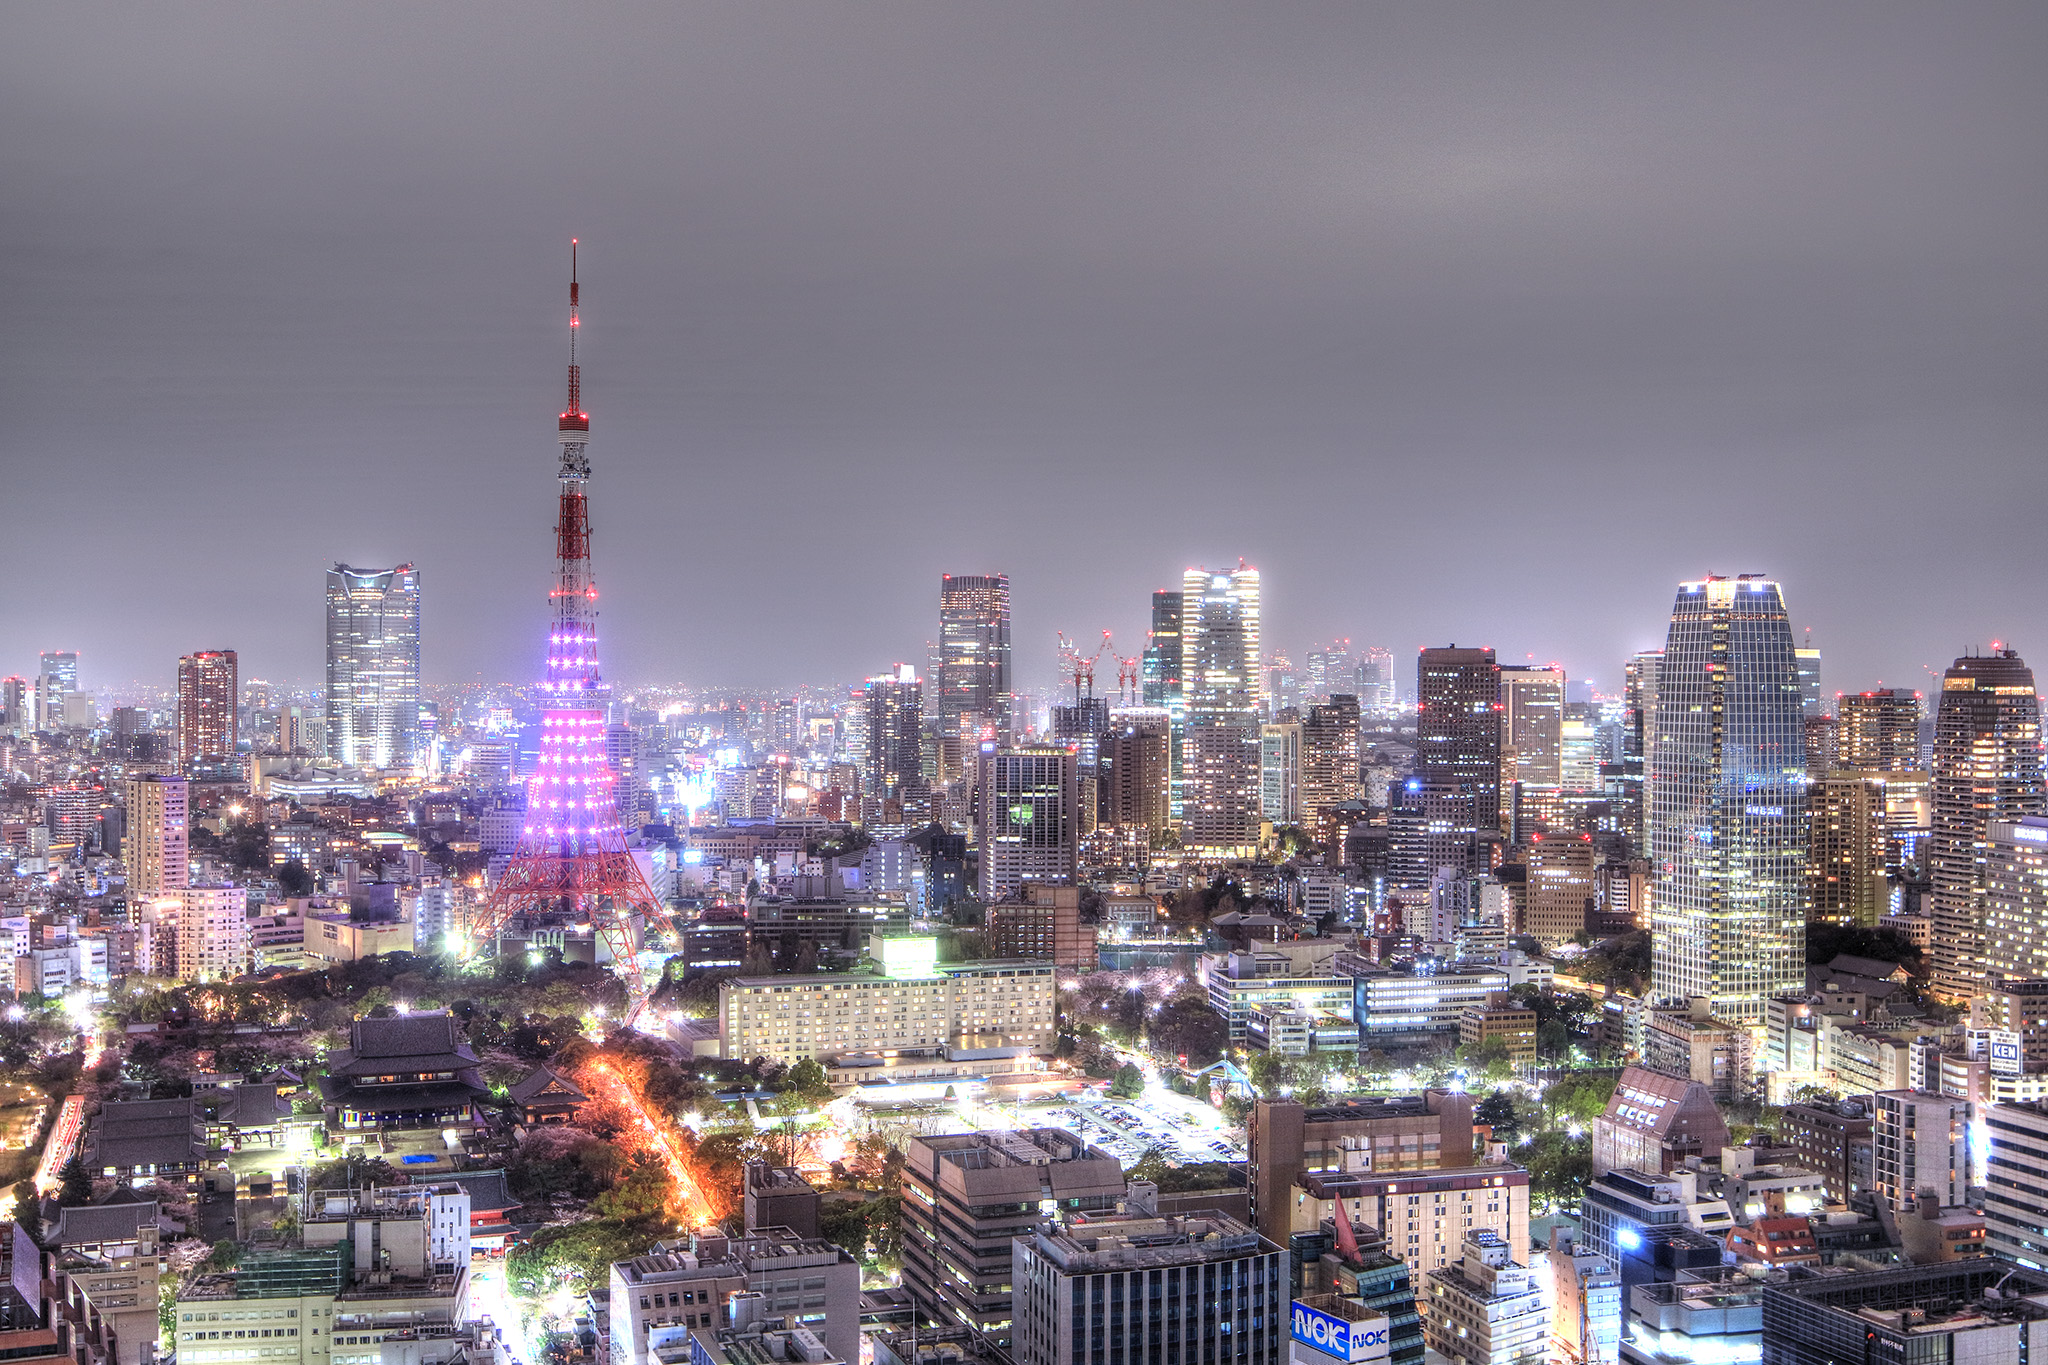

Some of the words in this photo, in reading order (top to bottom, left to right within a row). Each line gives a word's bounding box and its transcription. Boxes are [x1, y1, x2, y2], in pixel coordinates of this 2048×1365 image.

[1993, 1044, 2016, 1058] KEN
[1295, 1308, 1345, 1353] NOK
[1352, 1329, 1387, 1349] NOK
